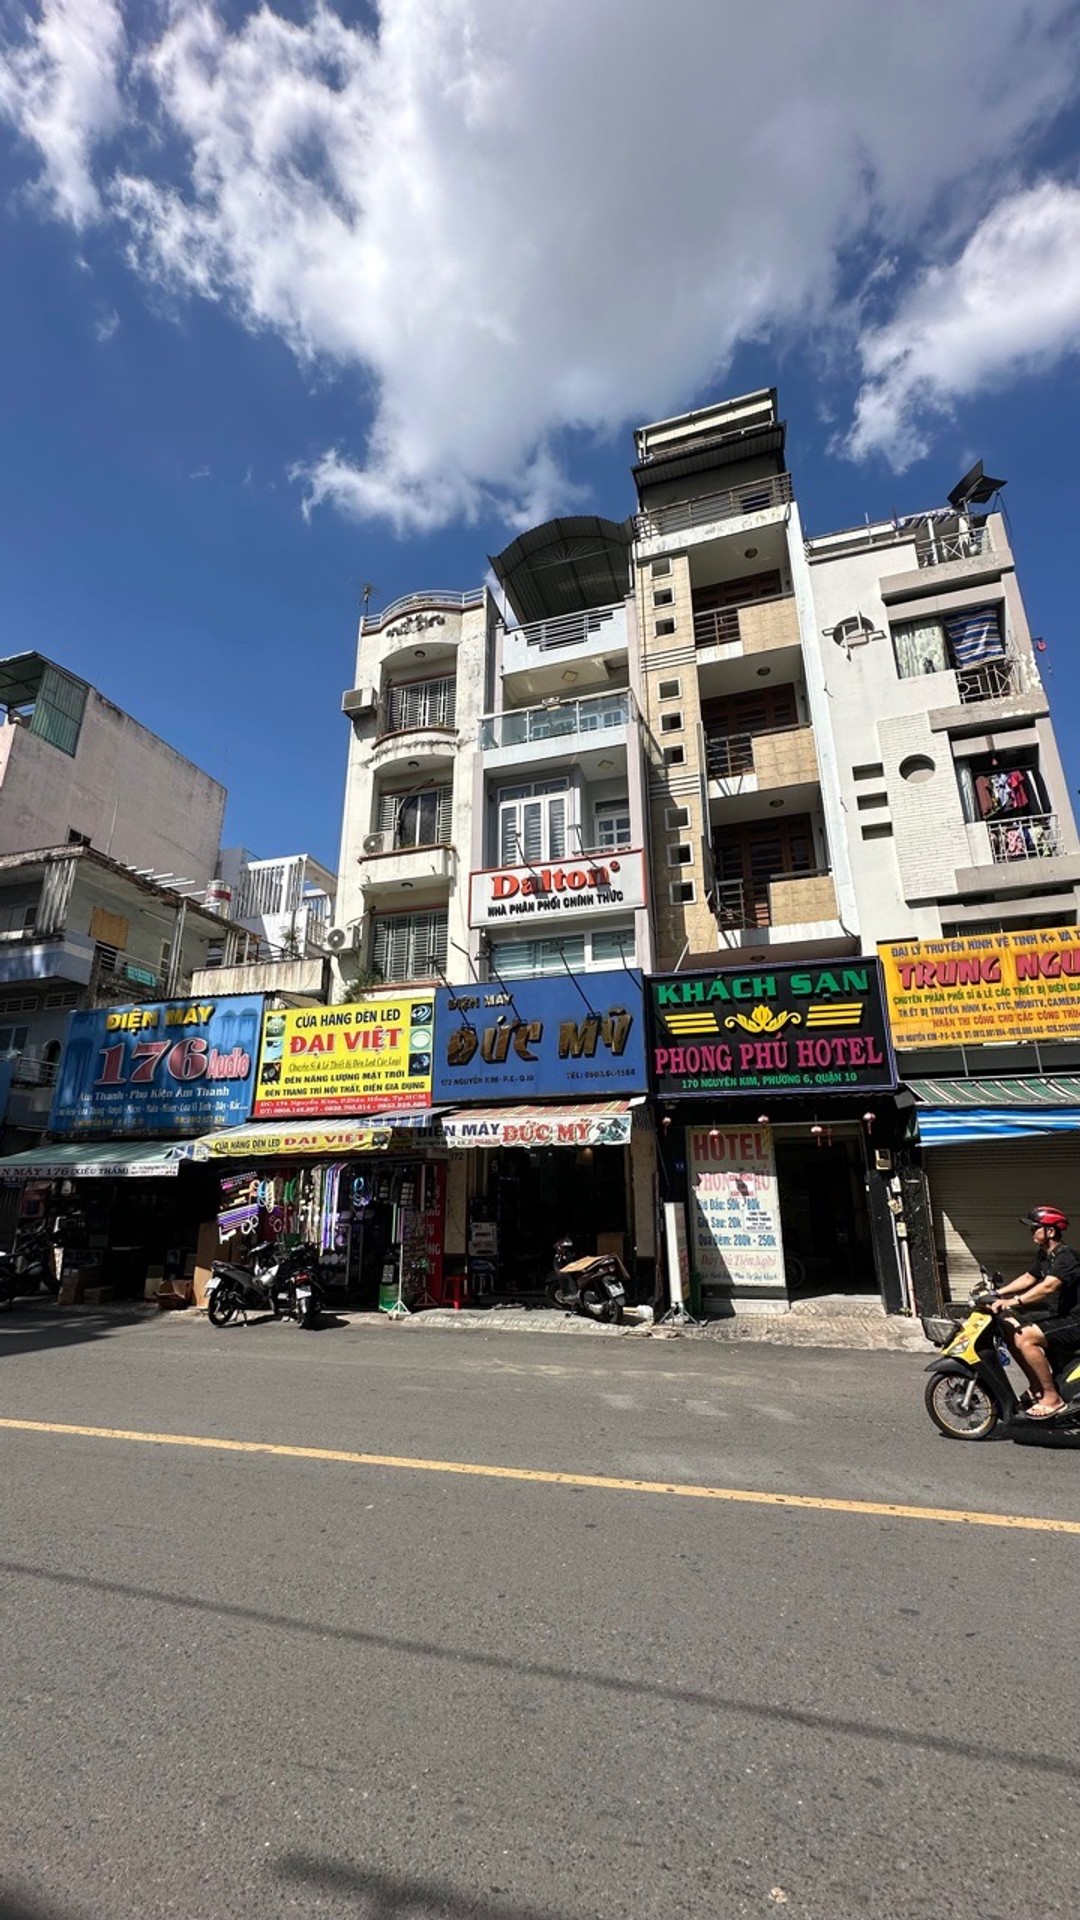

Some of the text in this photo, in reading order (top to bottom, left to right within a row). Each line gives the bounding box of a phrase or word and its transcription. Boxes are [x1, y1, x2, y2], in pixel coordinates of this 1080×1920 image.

[491, 866, 611, 900] Dalton
[488, 889, 624, 917] NHÀ PHÂN PHỐI CHÍNH THỨC
[1013, 934, 1038, 947] TINH
[658, 969, 869, 1005] KHÁCH SẠN
[898, 957, 1003, 991] TRUNG
[106, 1003, 214, 1034] ĐIỆN MÁY
[320, 1011, 352, 1028] HÀNG
[380, 1008, 401, 1022] LED
[290, 1025, 404, 1057] ĐẠI VIỆT
[654, 1032, 883, 1074] PHONG PHÚ HOTEL
[94, 1037, 250, 1085] 176 Audio
[197, 1086, 230, 1098] Thanh
[682, 1080, 699, 1088] 170
[815, 1073, 842, 1085] QUẬN
[845, 1072, 858, 1082] 10
[267, 1138, 281, 1148] LED
[462, 1120, 500, 1136] MÁY
[502, 1119, 551, 1143] ĐỨC
[557, 1117, 594, 1142] MỸ
[693, 1132, 769, 1161] HOTEL
[46, 1166, 68, 1176] 176
[758, 1234, 776, 1246] 250k
